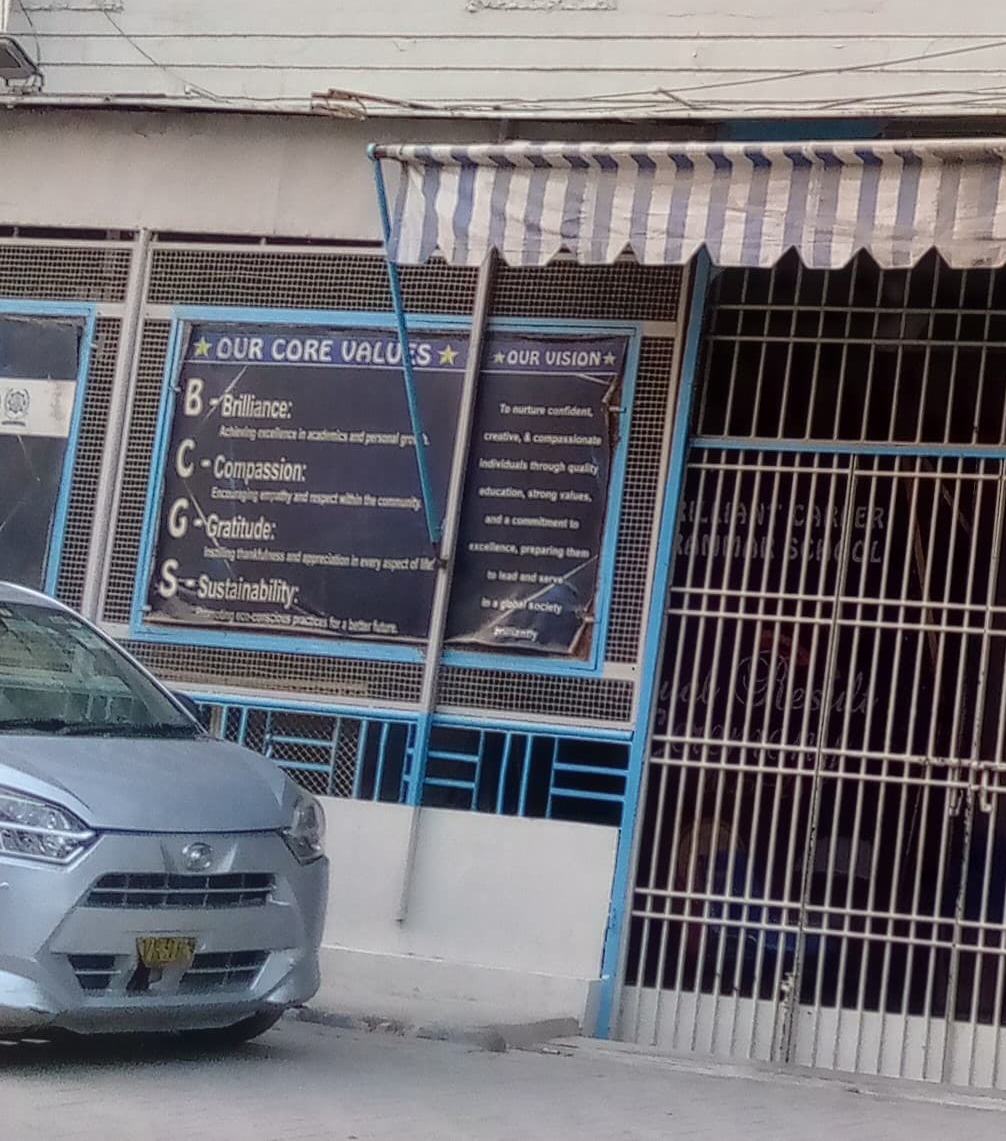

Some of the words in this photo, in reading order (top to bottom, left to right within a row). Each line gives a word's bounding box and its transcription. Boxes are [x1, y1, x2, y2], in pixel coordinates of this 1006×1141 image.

[216, 337, 263, 359] OUR
[271, 337, 333, 362] CORE
[506, 350, 540, 365] OUR
[545, 351, 601, 366] VISION
[184, 377, 205, 416] B
[500, 403, 511, 414] To
[512, 405, 546, 415] nurture
[219, 425, 256, 441] Achieving
[257, 427, 297, 440] excellence
[306, 429, 347, 442] academics
[347, 431, 365, 442] and
[365, 432, 400, 446] personal
[533, 434, 602, 446] compassionate
[176, 438, 196, 478] C
[529, 460, 566, 474] through
[567, 462, 598, 476] quality
[211, 486, 258, 503] Encouraging
[260, 489, 293, 505] empathy
[293, 491, 308, 503] and
[309, 493, 338, 507] respect
[363, 494, 377, 506] the
[527, 488, 558, 502] strong
[168, 497, 189, 538] G
[484, 514, 503, 526] and
[511, 517, 567, 529] commitment
[569, 519, 579, 529] to
[236, 547, 285, 562] thankfulness
[286, 551, 302, 563] and
[302, 552, 350, 567] appreciation
[520, 544, 564, 558] preparing
[566, 546, 590, 558] them
[159, 559, 179, 599] S
[487, 570, 497, 580] to
[498, 570, 518, 581] lead
[519, 572, 537, 583] and
[538, 574, 564, 584] serve
[528, 601, 562, 616] society
